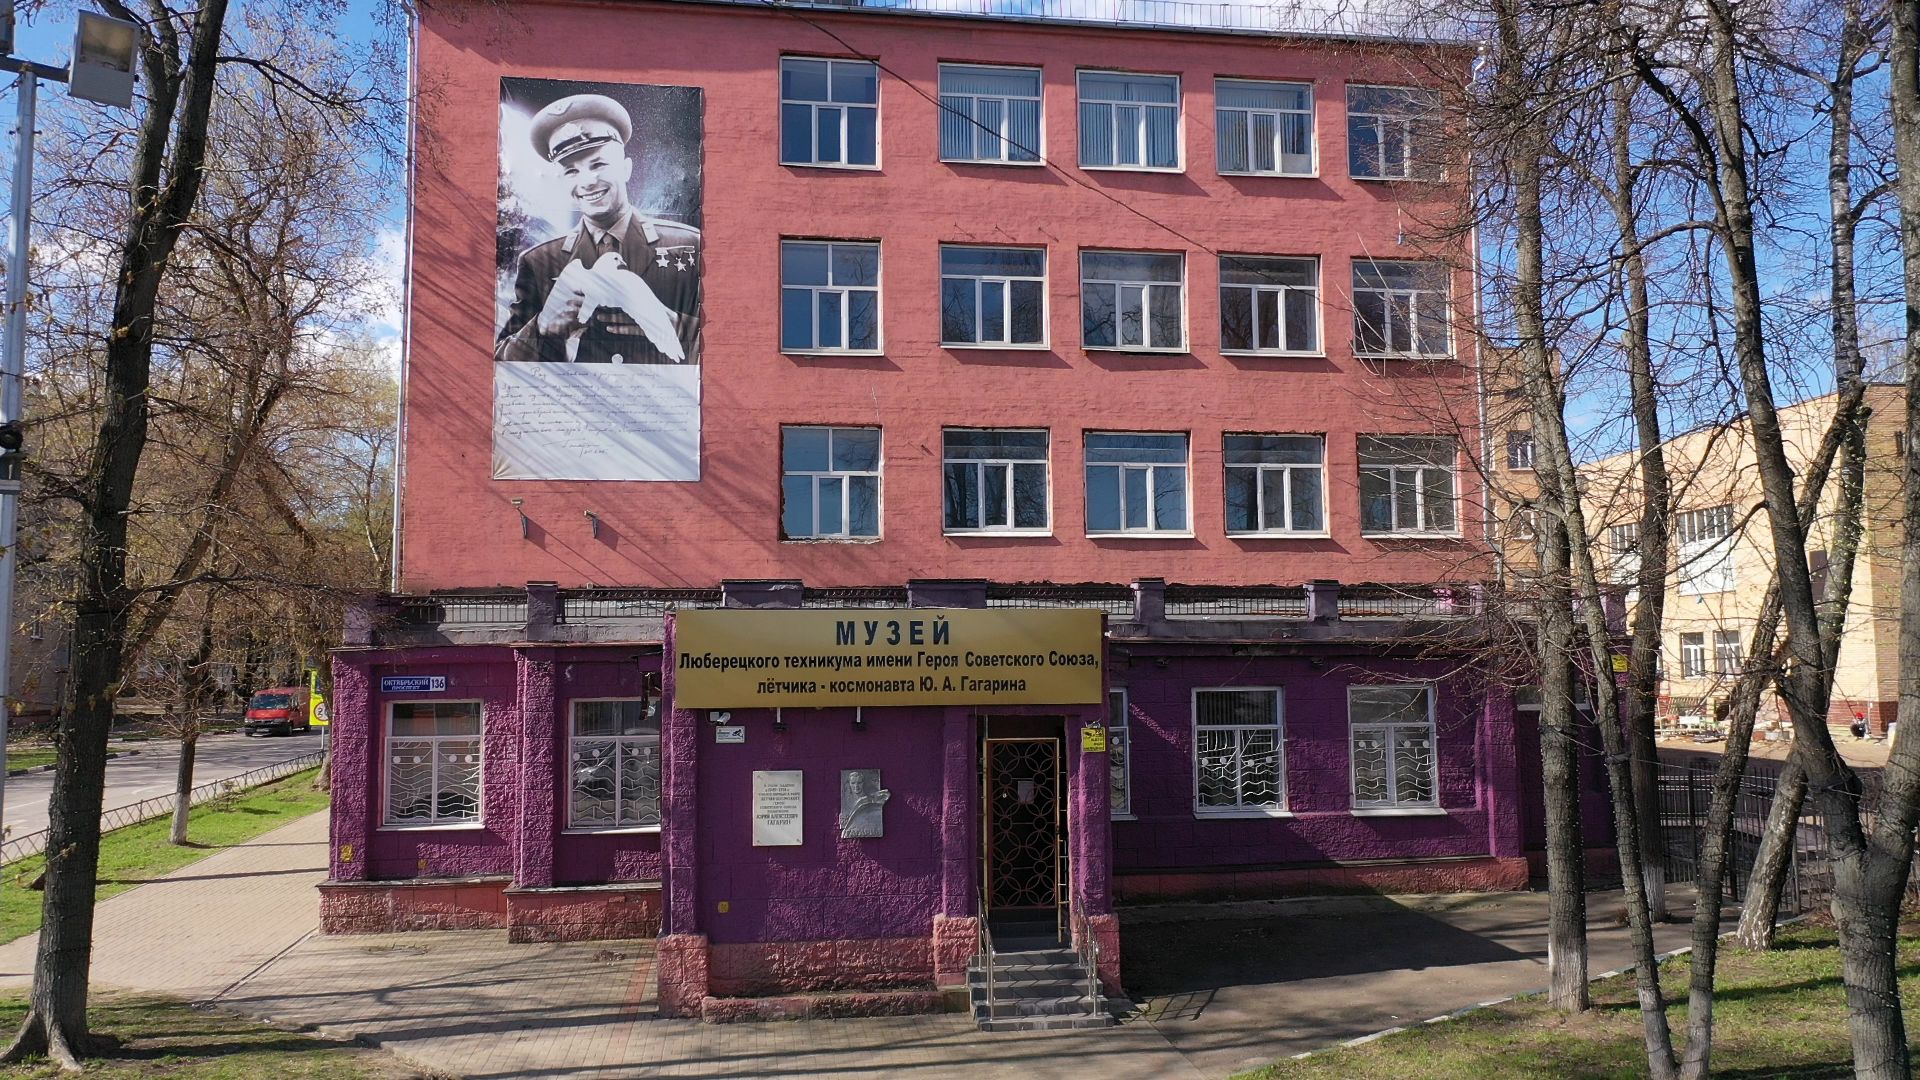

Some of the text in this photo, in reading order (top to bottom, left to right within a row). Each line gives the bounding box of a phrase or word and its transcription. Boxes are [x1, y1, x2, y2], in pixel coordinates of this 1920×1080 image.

[835, 614, 950, 646] МУЗЕЙ
[679, 650, 1099, 672] Люберецкого техникума имени Героя Советского Союза,
[431, 678, 445, 689] 136
[756, 677, 817, 694] лётчика
[829, 679, 915, 693] космонавта
[919, 676, 938, 692] Ю.
[942, 676, 957, 691] А.
[960, 675, 1027, 695] Гагарина
